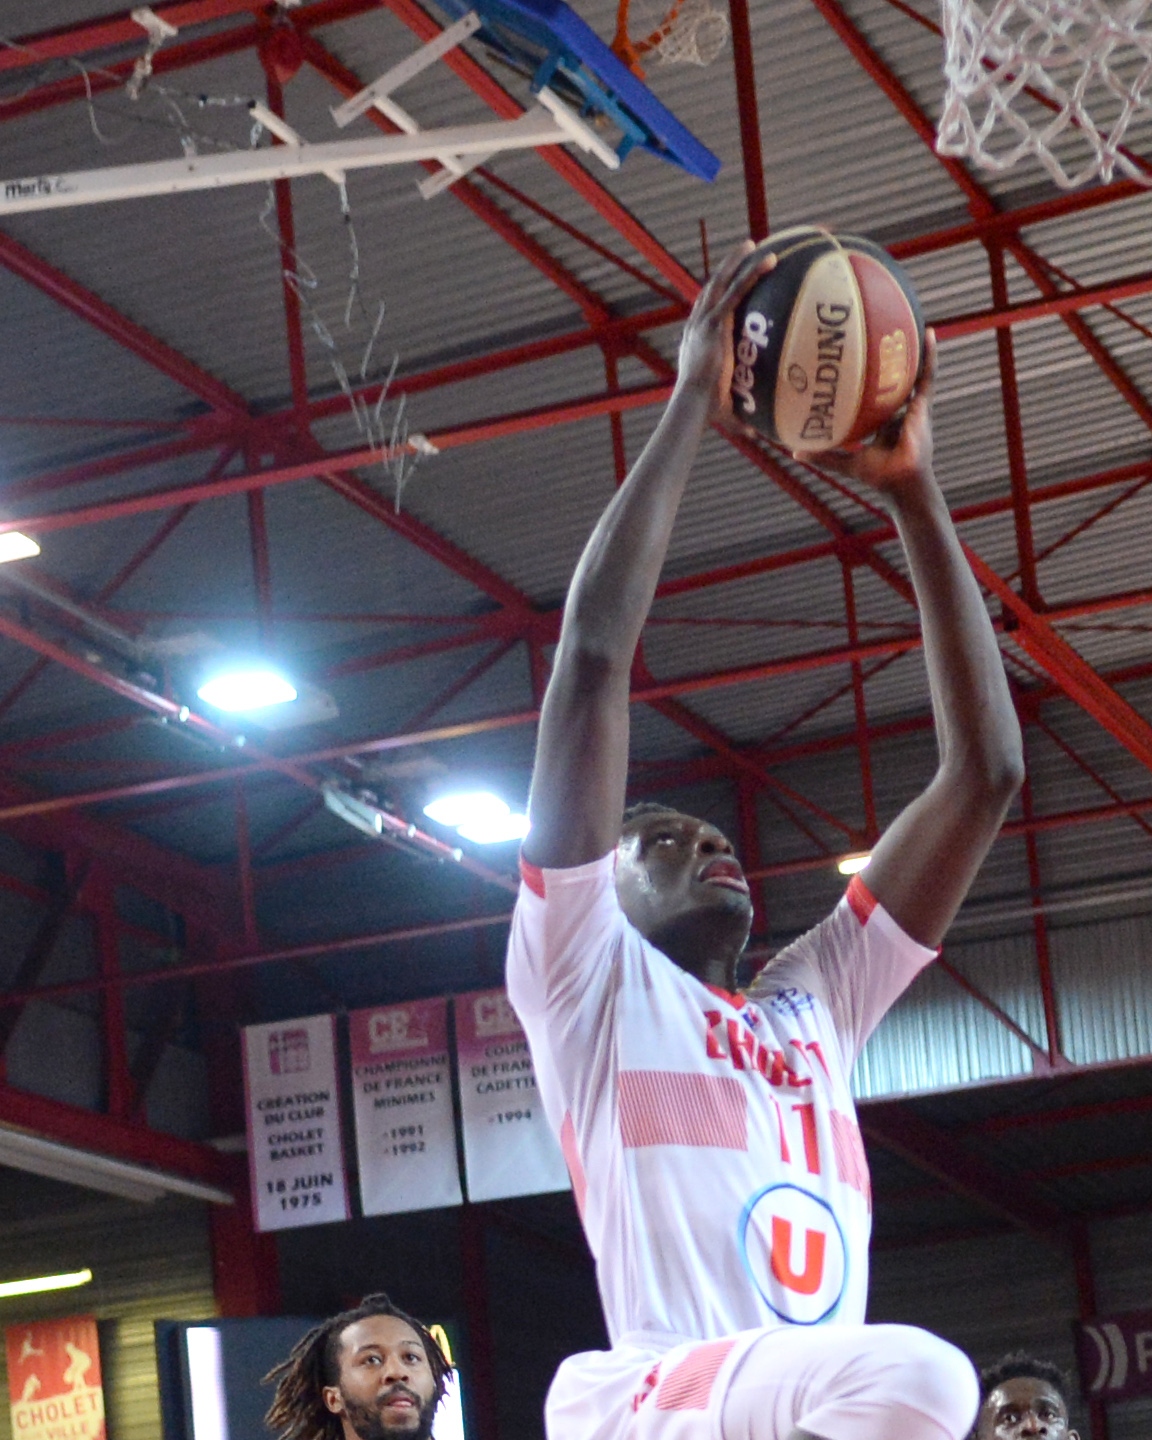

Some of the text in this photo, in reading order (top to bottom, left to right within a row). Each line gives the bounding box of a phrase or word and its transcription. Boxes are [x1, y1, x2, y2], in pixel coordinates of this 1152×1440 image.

[800, 302, 850, 441] PALDING
[493, 1060, 532, 1076] FRAN
[386, 1072, 443, 1091] FRANCE
[267, 1128, 324, 1146] CHOLET
[291, 1173, 334, 1192] JUIN
[280, 1192, 322, 1211] 1975
[16, 1393, 98, 1429] CHOLET
